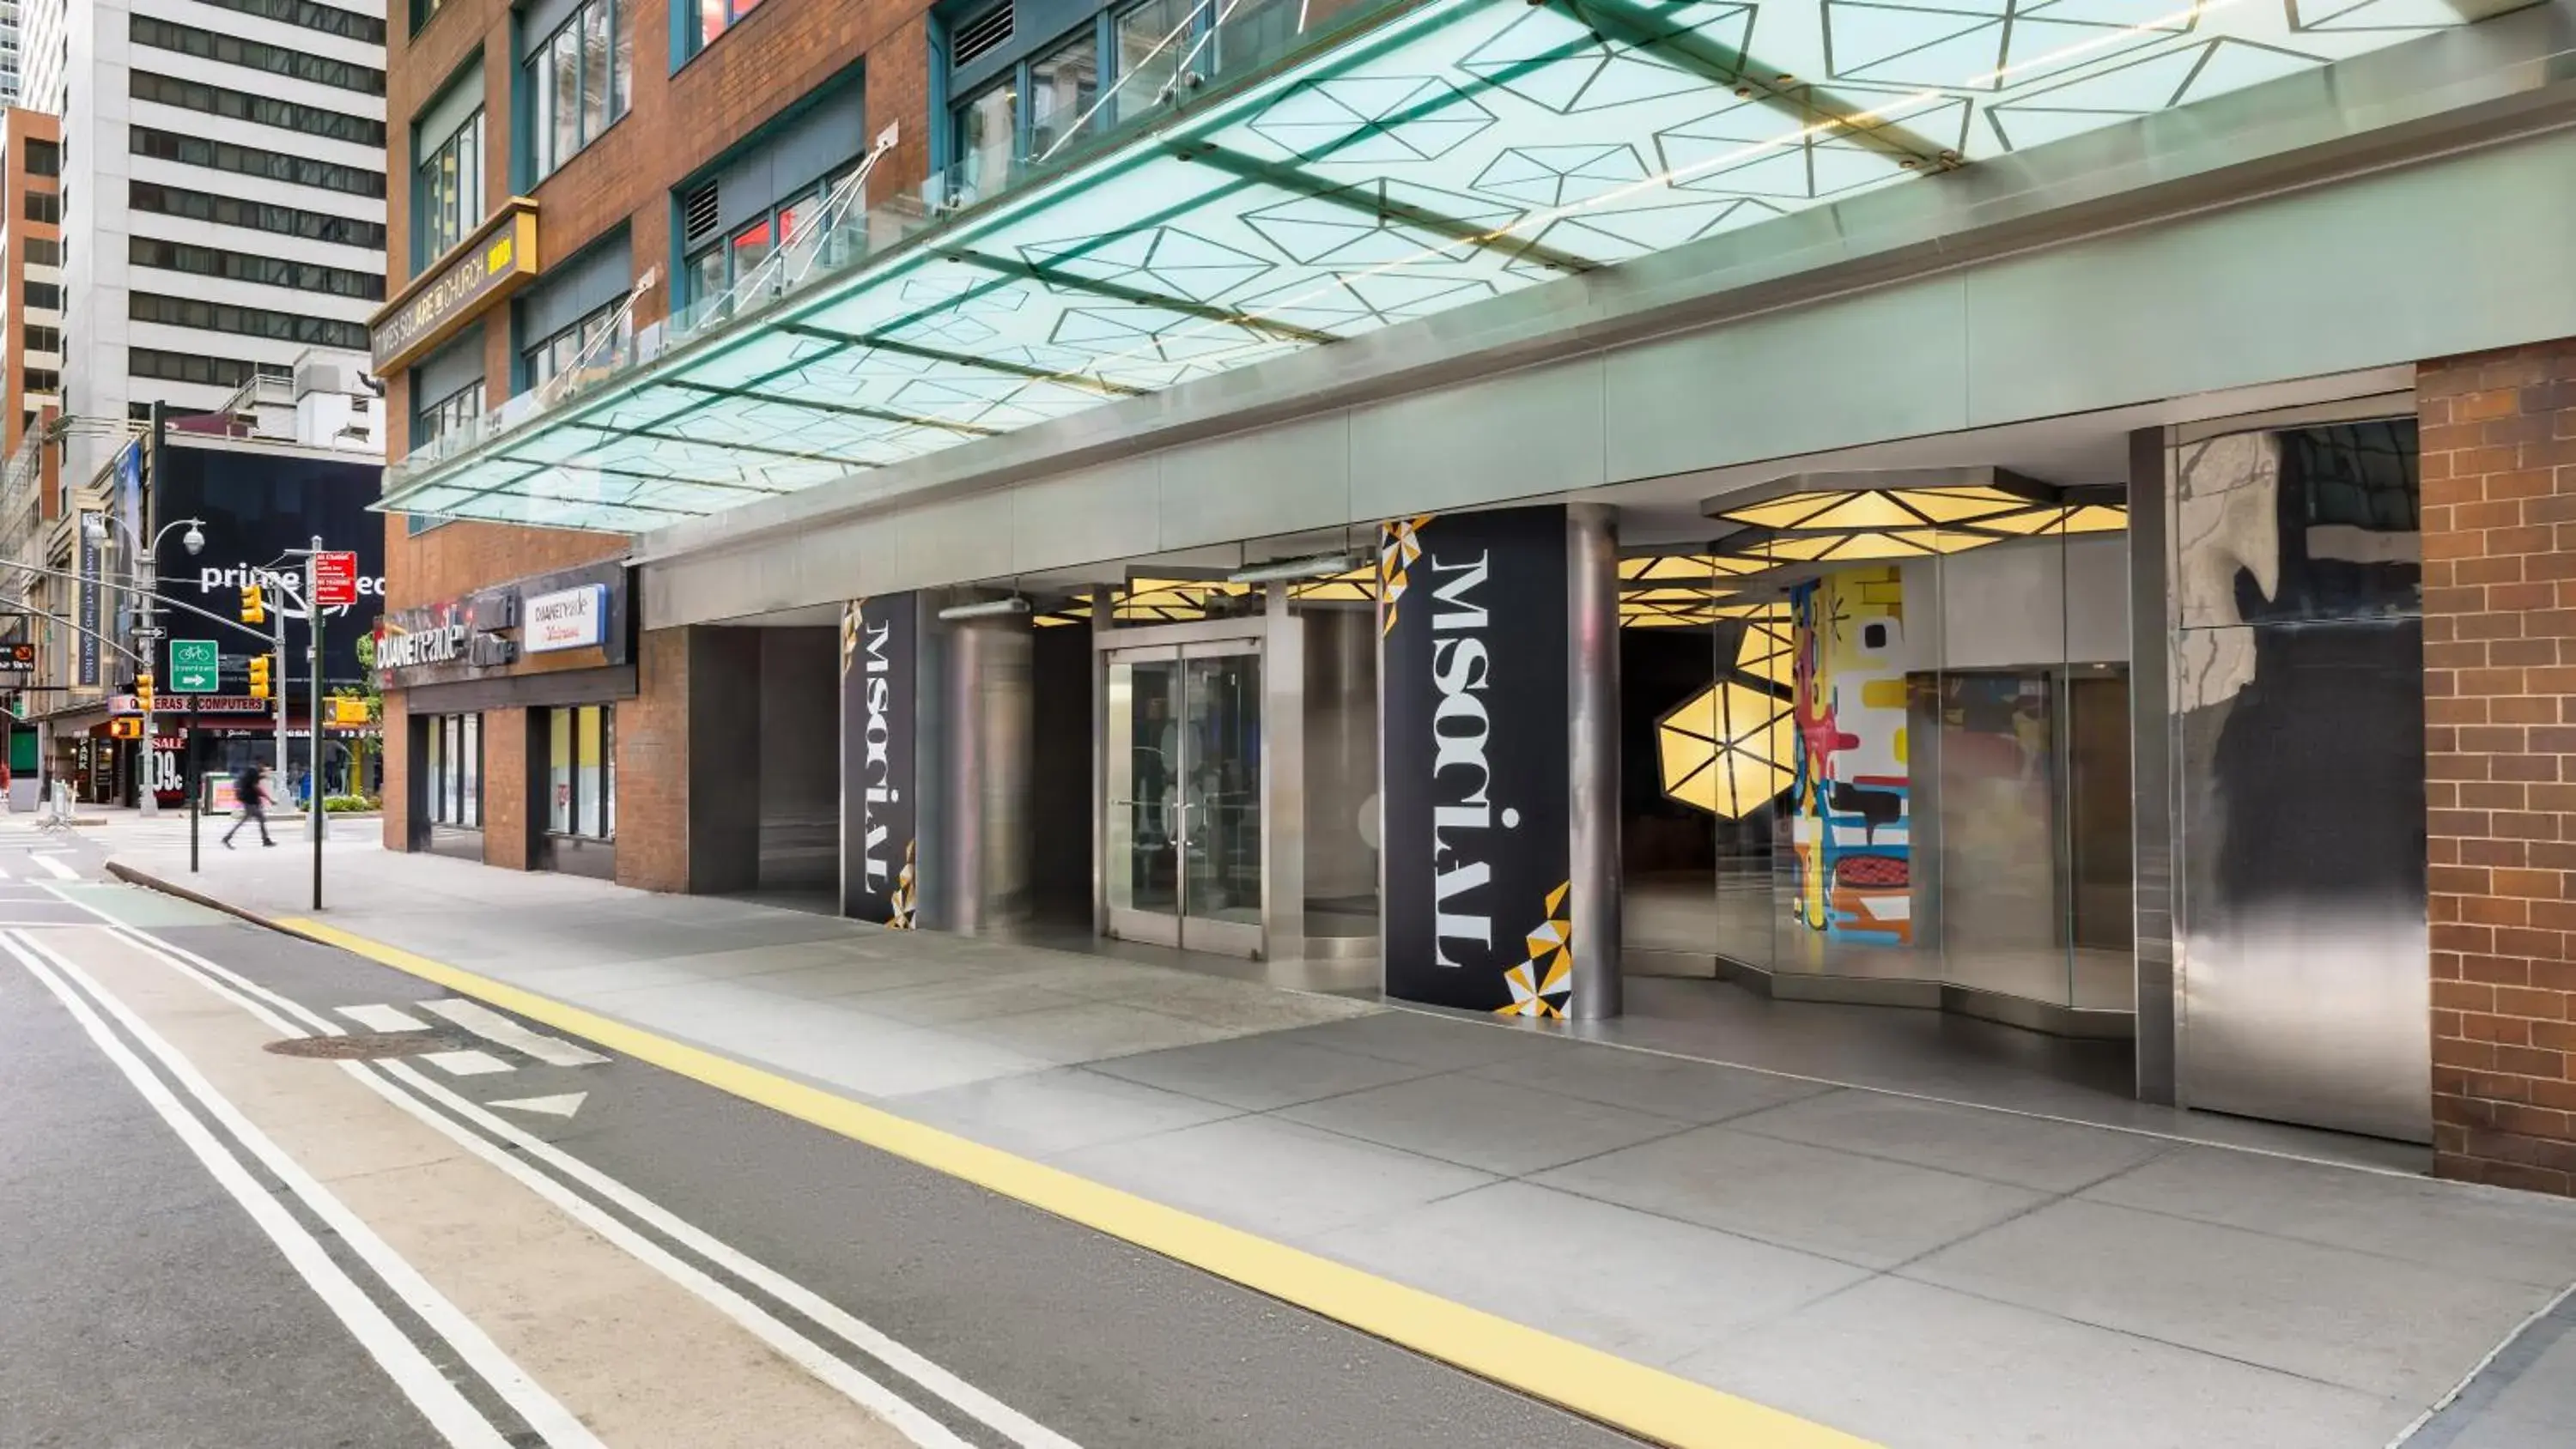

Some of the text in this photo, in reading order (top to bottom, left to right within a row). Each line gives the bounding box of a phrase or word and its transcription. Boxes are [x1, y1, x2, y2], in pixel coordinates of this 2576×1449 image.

[201, 562, 300, 593] prime
[198, 698, 262, 710] COMPUTERS
[152, 737, 185, 749] SALE
